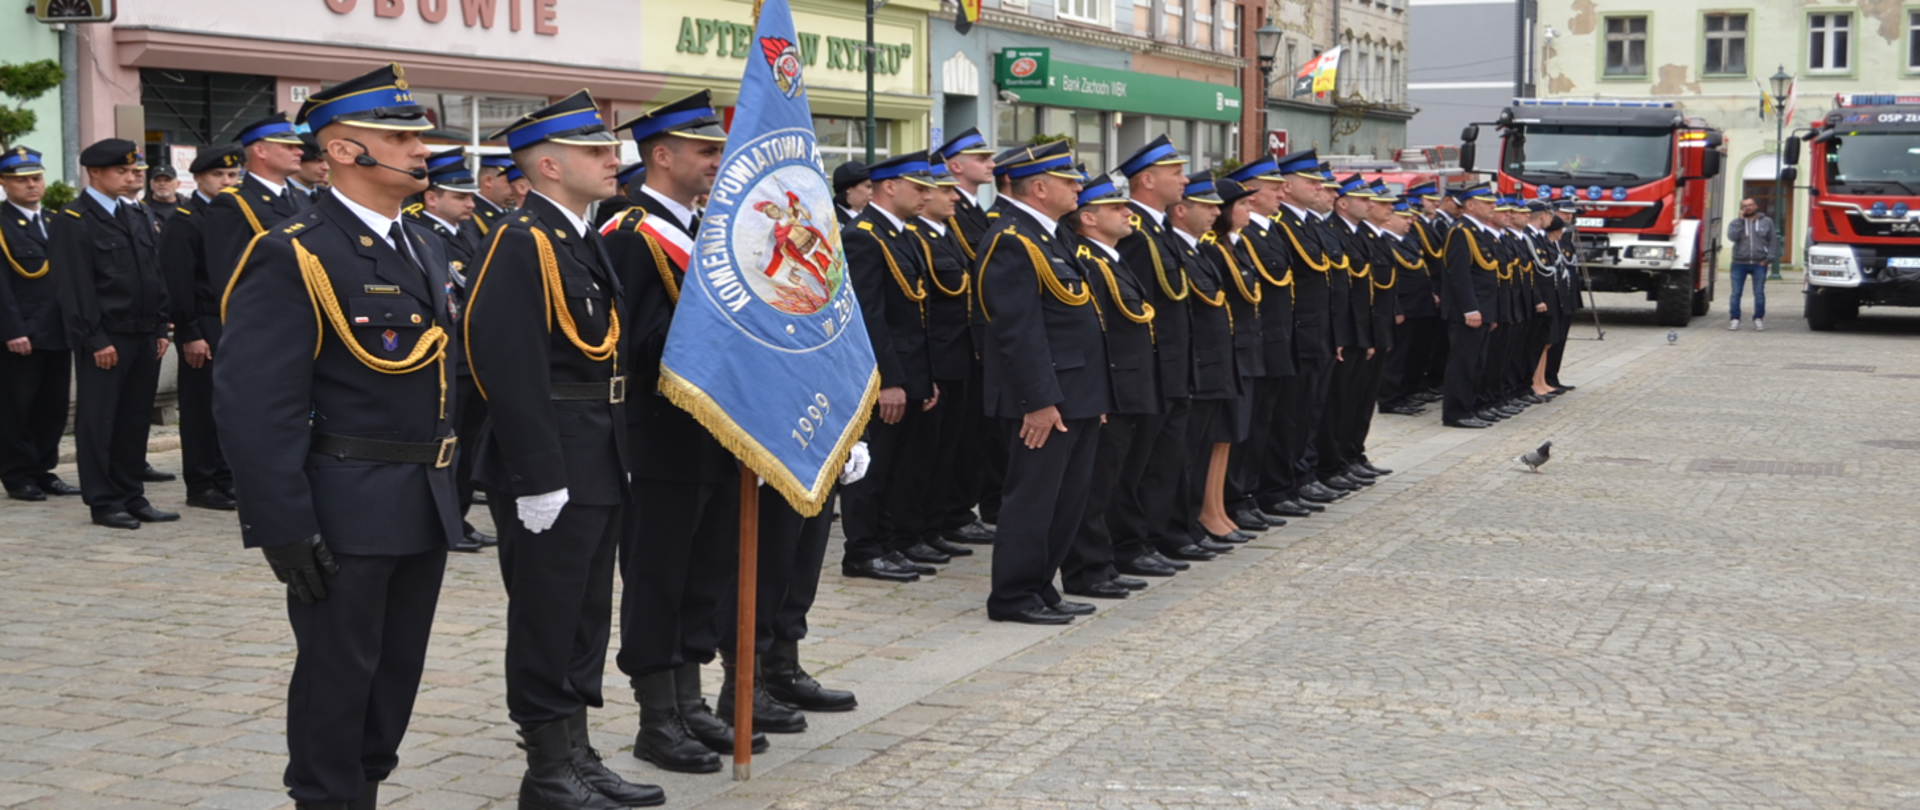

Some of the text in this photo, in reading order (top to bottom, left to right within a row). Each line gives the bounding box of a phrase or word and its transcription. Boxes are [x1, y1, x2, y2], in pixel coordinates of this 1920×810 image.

[676, 16, 754, 59] APTE
[1063, 74, 1080, 92] Bank
[1081, 76, 1110, 96] Zachodni
[1111, 80, 1127, 98] WBK
[1878, 113, 1903, 123] OSP
[714, 135, 806, 206] POWIATOWA
[1891, 223, 1920, 233] MA
[701, 212, 752, 313] KOMENDA
[791, 392, 830, 451] 1999
